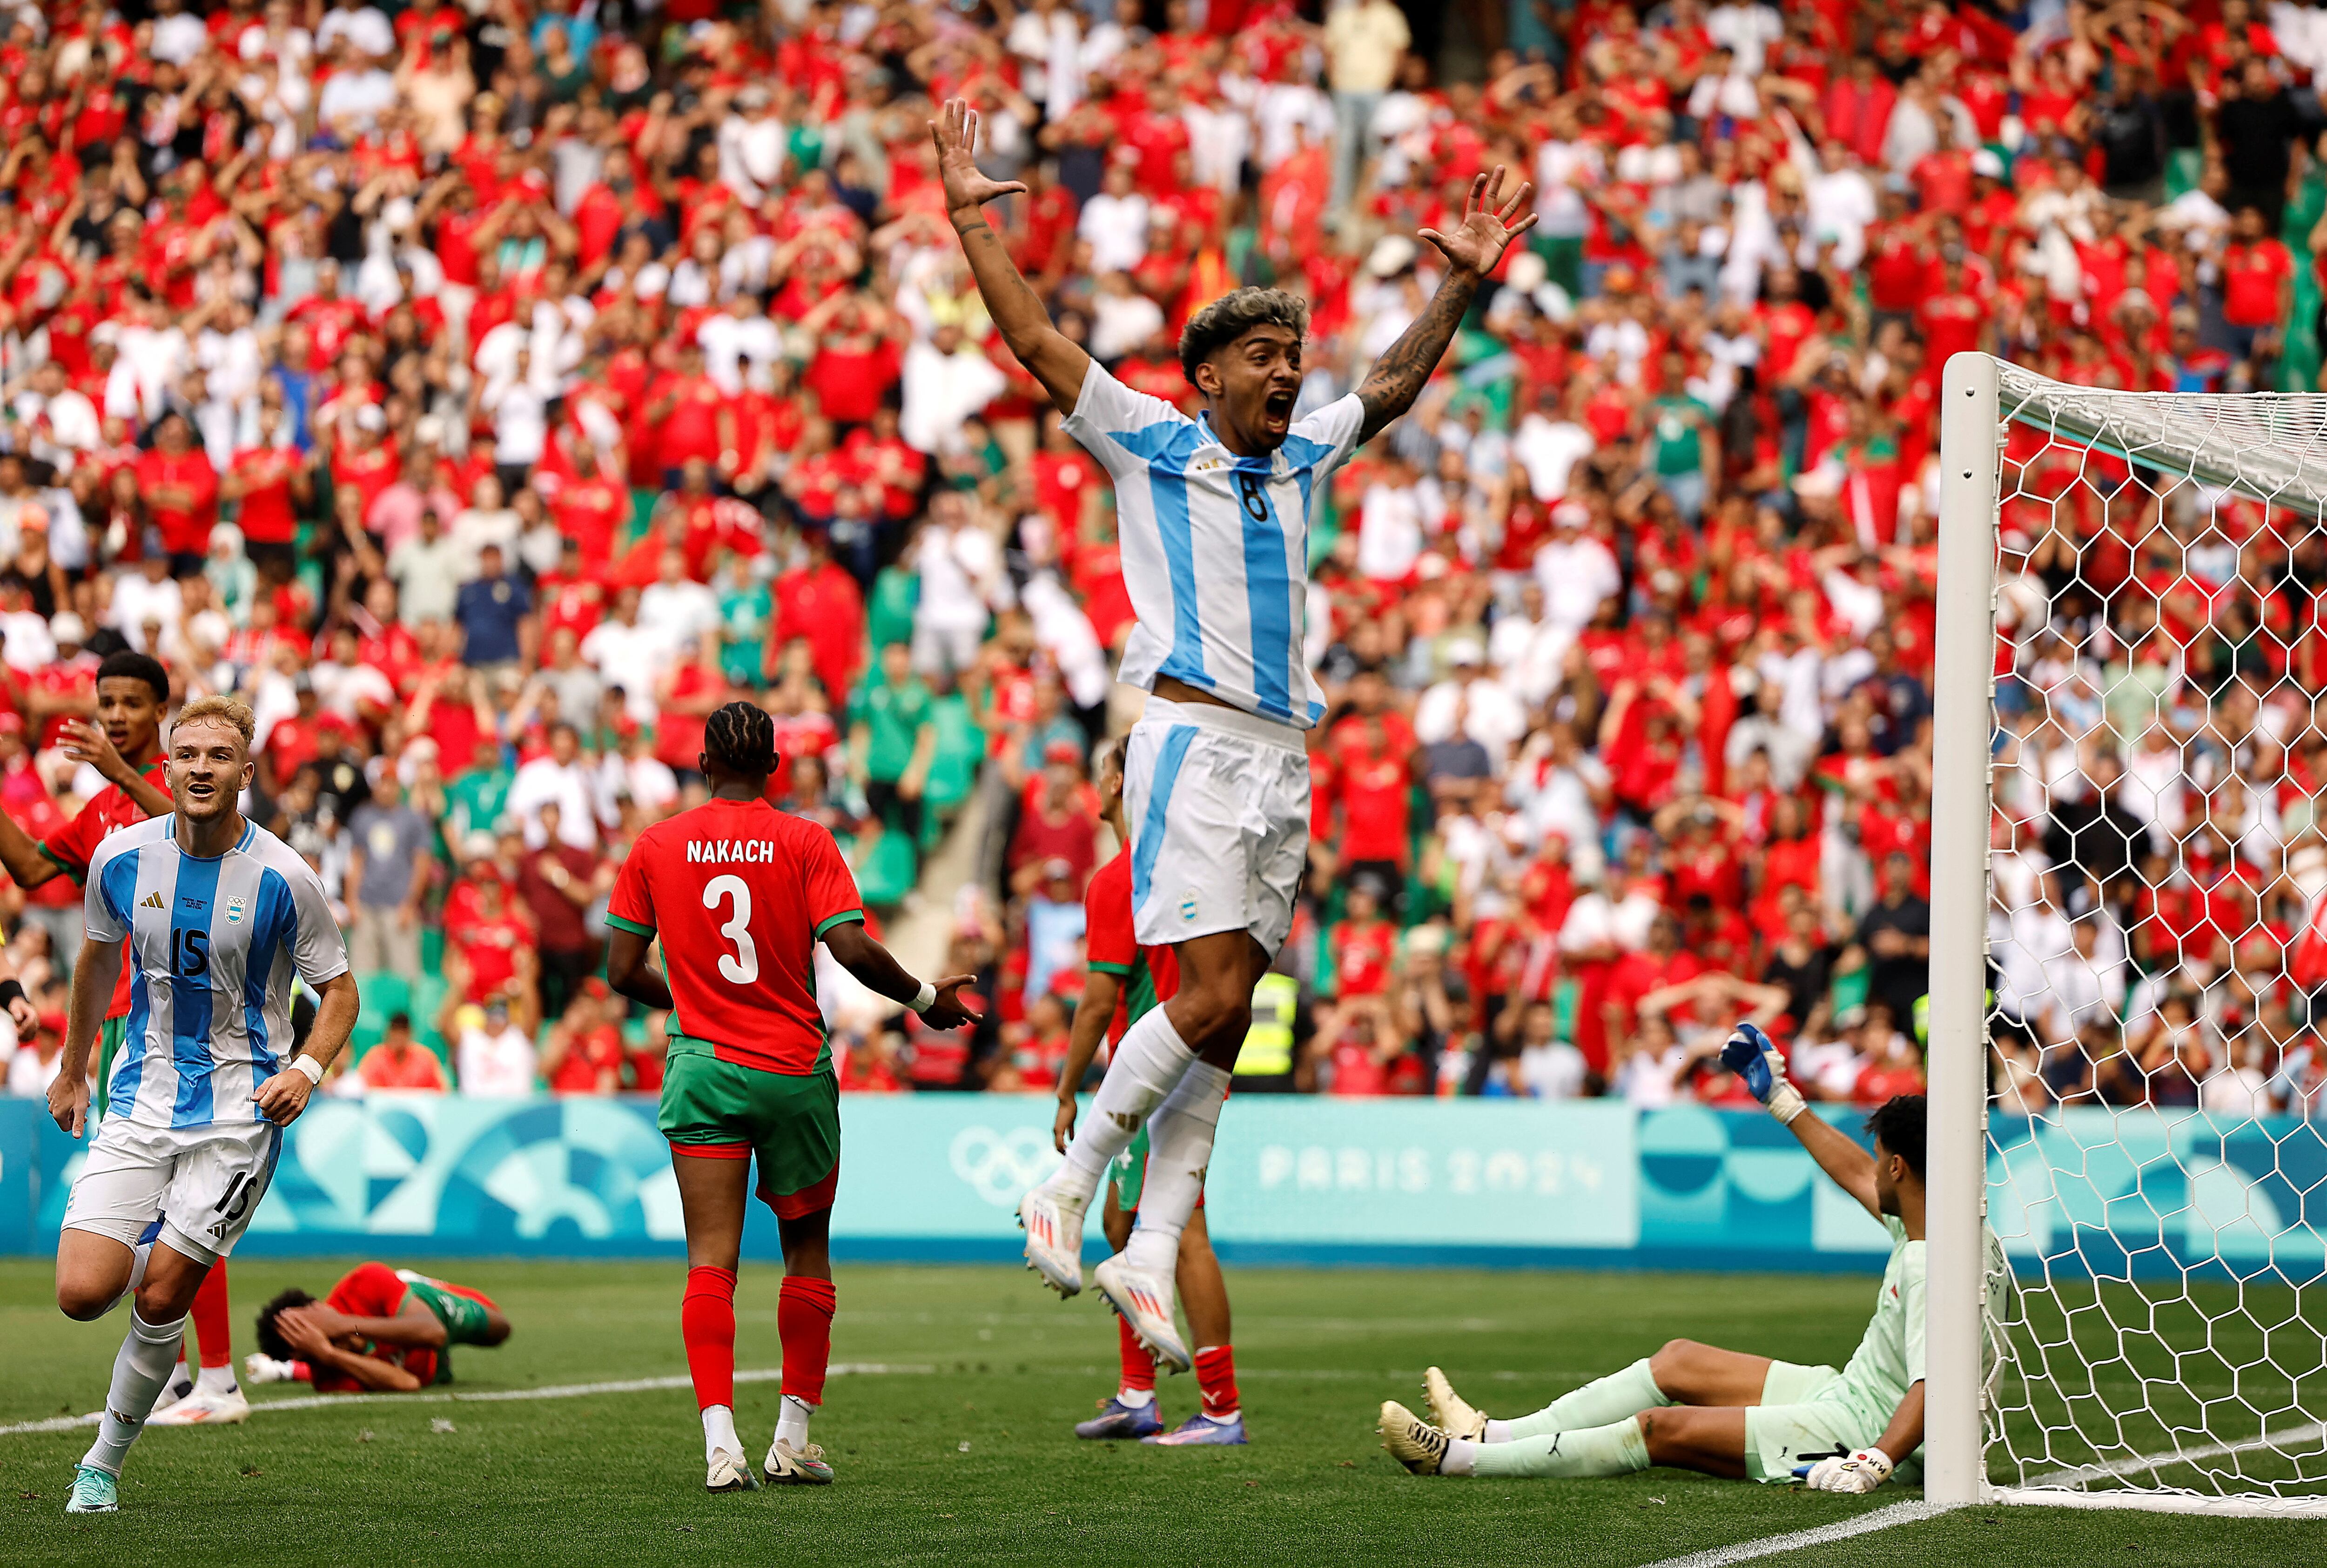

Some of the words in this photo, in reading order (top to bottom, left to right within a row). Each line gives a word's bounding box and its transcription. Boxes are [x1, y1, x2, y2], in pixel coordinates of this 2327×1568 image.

[1239, 472, 1268, 522] 8
[687, 839, 774, 863] NAKACH
[171, 927, 208, 976] 15
[702, 874, 759, 984] 3
[1259, 1145, 1429, 1192] PARIS
[1446, 1147, 1604, 1195] 2024
[214, 1171, 258, 1221] 15
